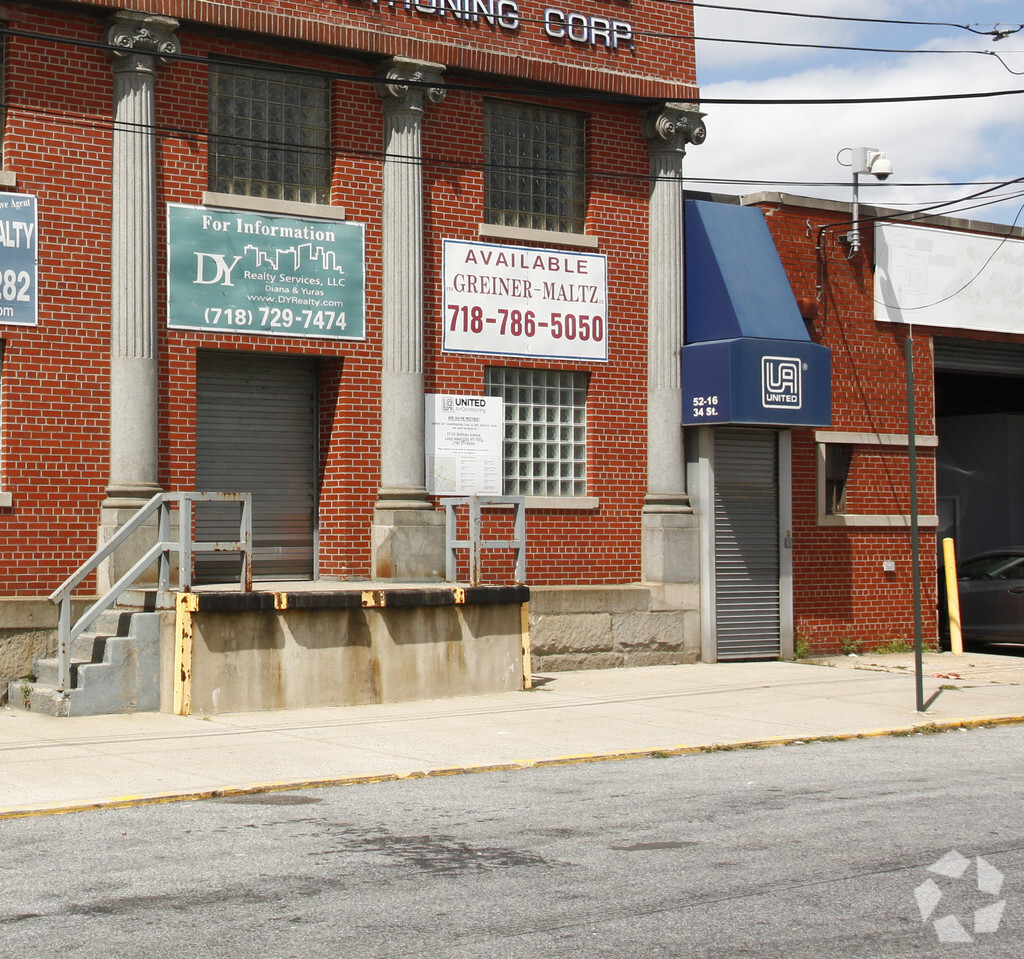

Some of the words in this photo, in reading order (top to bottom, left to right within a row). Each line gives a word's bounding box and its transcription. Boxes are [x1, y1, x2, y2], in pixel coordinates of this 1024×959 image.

[544, 8, 635, 50] CORP.
[11, 198, 30, 210] Agent
[202, 215, 230, 232] For
[236, 218, 336, 242] Information
[193, 252, 242, 286] DY
[465, 249, 588, 274] AVAILABLE
[244, 271, 276, 282] Realty
[280, 274, 324, 286] Services,
[328, 278, 346, 286] LLC
[265, 285, 290, 294] Diana
[292, 286, 298, 294] &
[300, 288, 324, 296] Yuras
[453, 274, 598, 304] GREINER-MALTZ
[246, 294, 343, 307] www.DYRealty.com
[204, 308, 253, 326] (718)
[258, 307, 346, 330] 729-7474
[448, 304, 603, 342] 718-786-5050
[456, 398, 486, 407] UNITED
[692, 396, 718, 406] 52-16
[766, 394, 798, 402] UNITED
[693, 408, 704, 416] 34
[706, 407, 718, 416] St.
